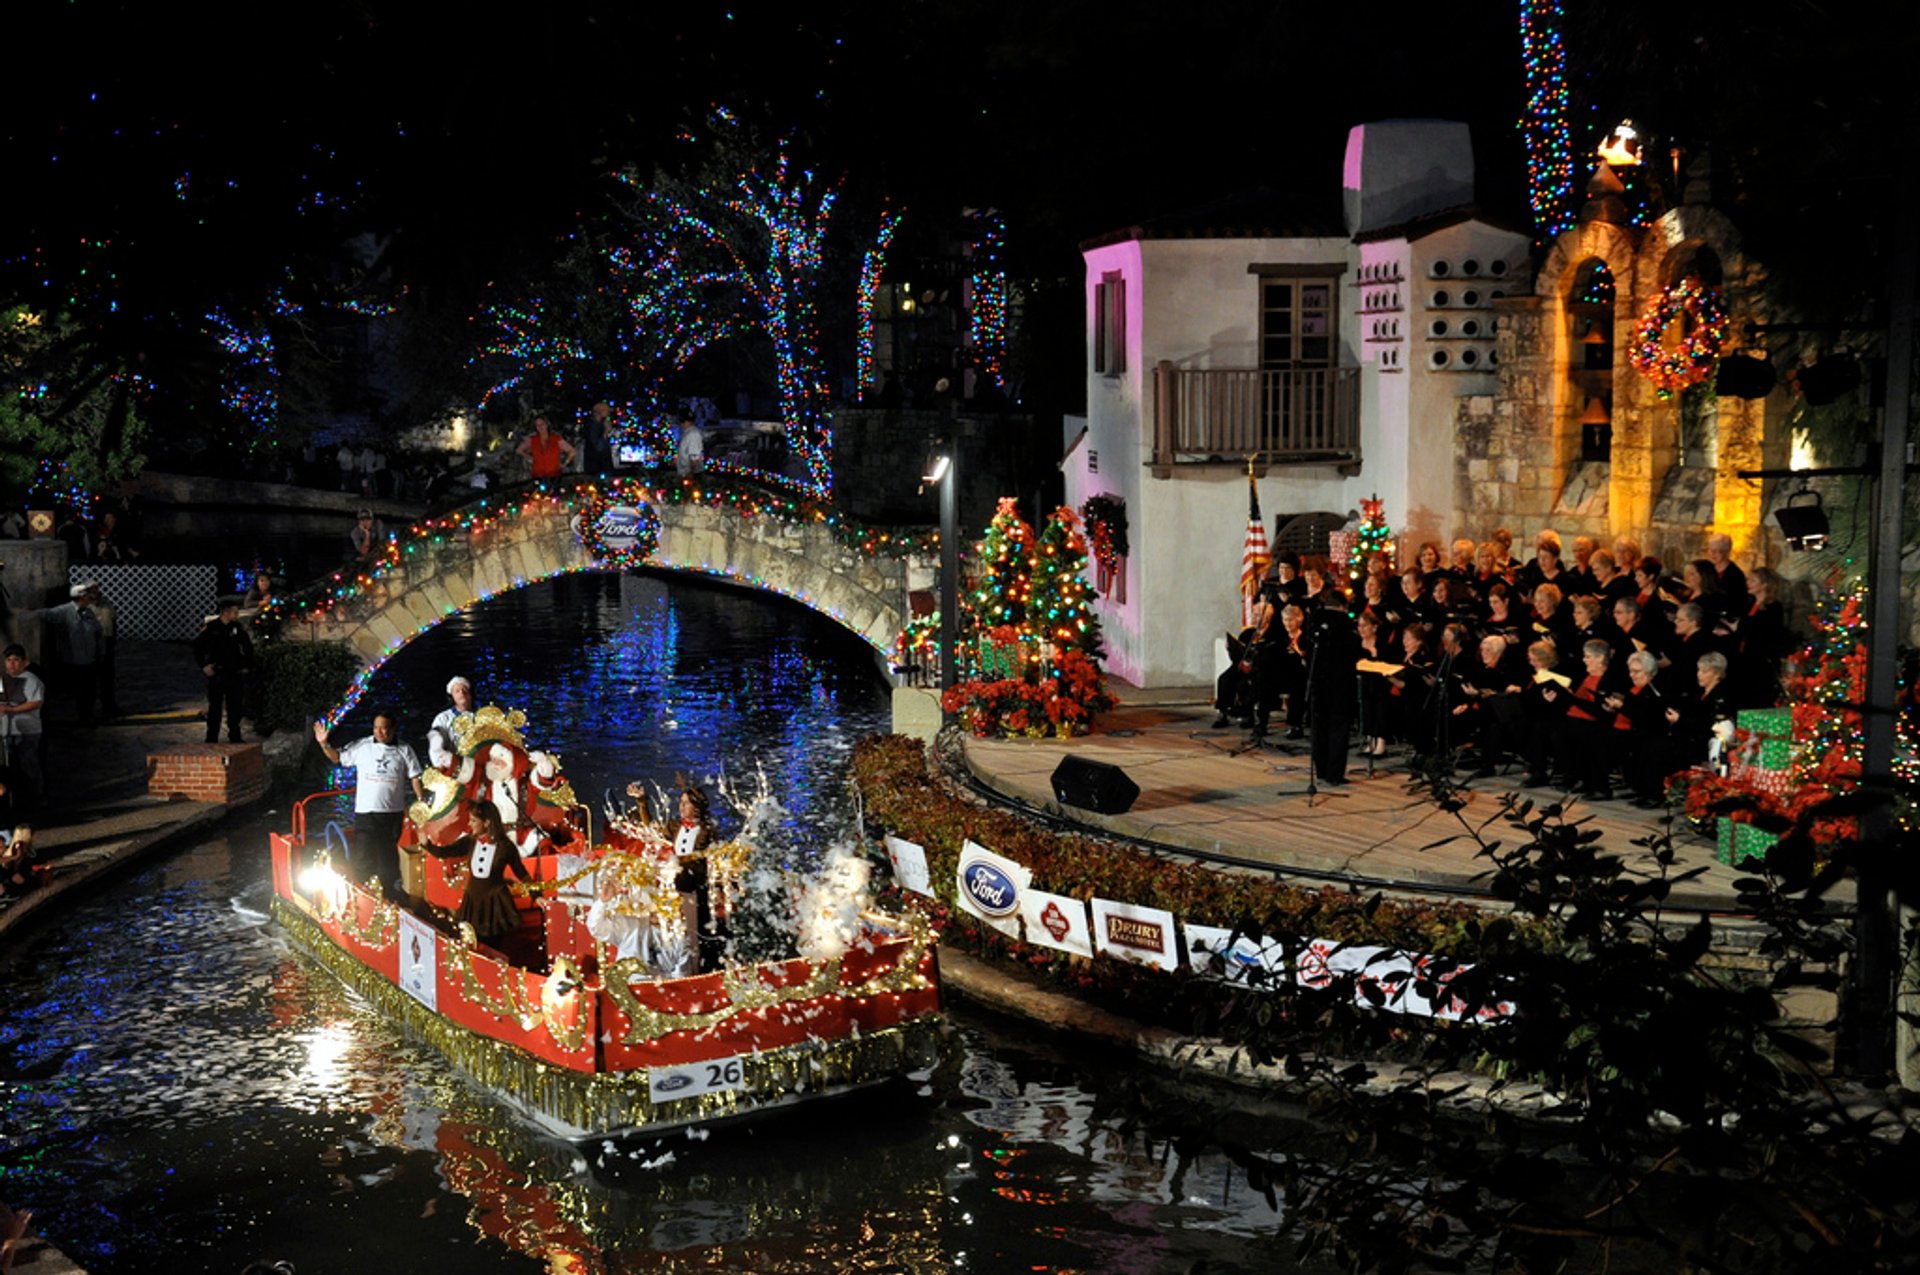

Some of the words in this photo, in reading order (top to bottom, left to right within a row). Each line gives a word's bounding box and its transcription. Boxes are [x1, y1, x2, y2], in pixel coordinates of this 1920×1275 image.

[596, 515, 641, 536] Ford
[971, 867, 1006, 906] Ford
[1108, 917, 1160, 939] DRURY
[705, 1060, 741, 1087] 26
